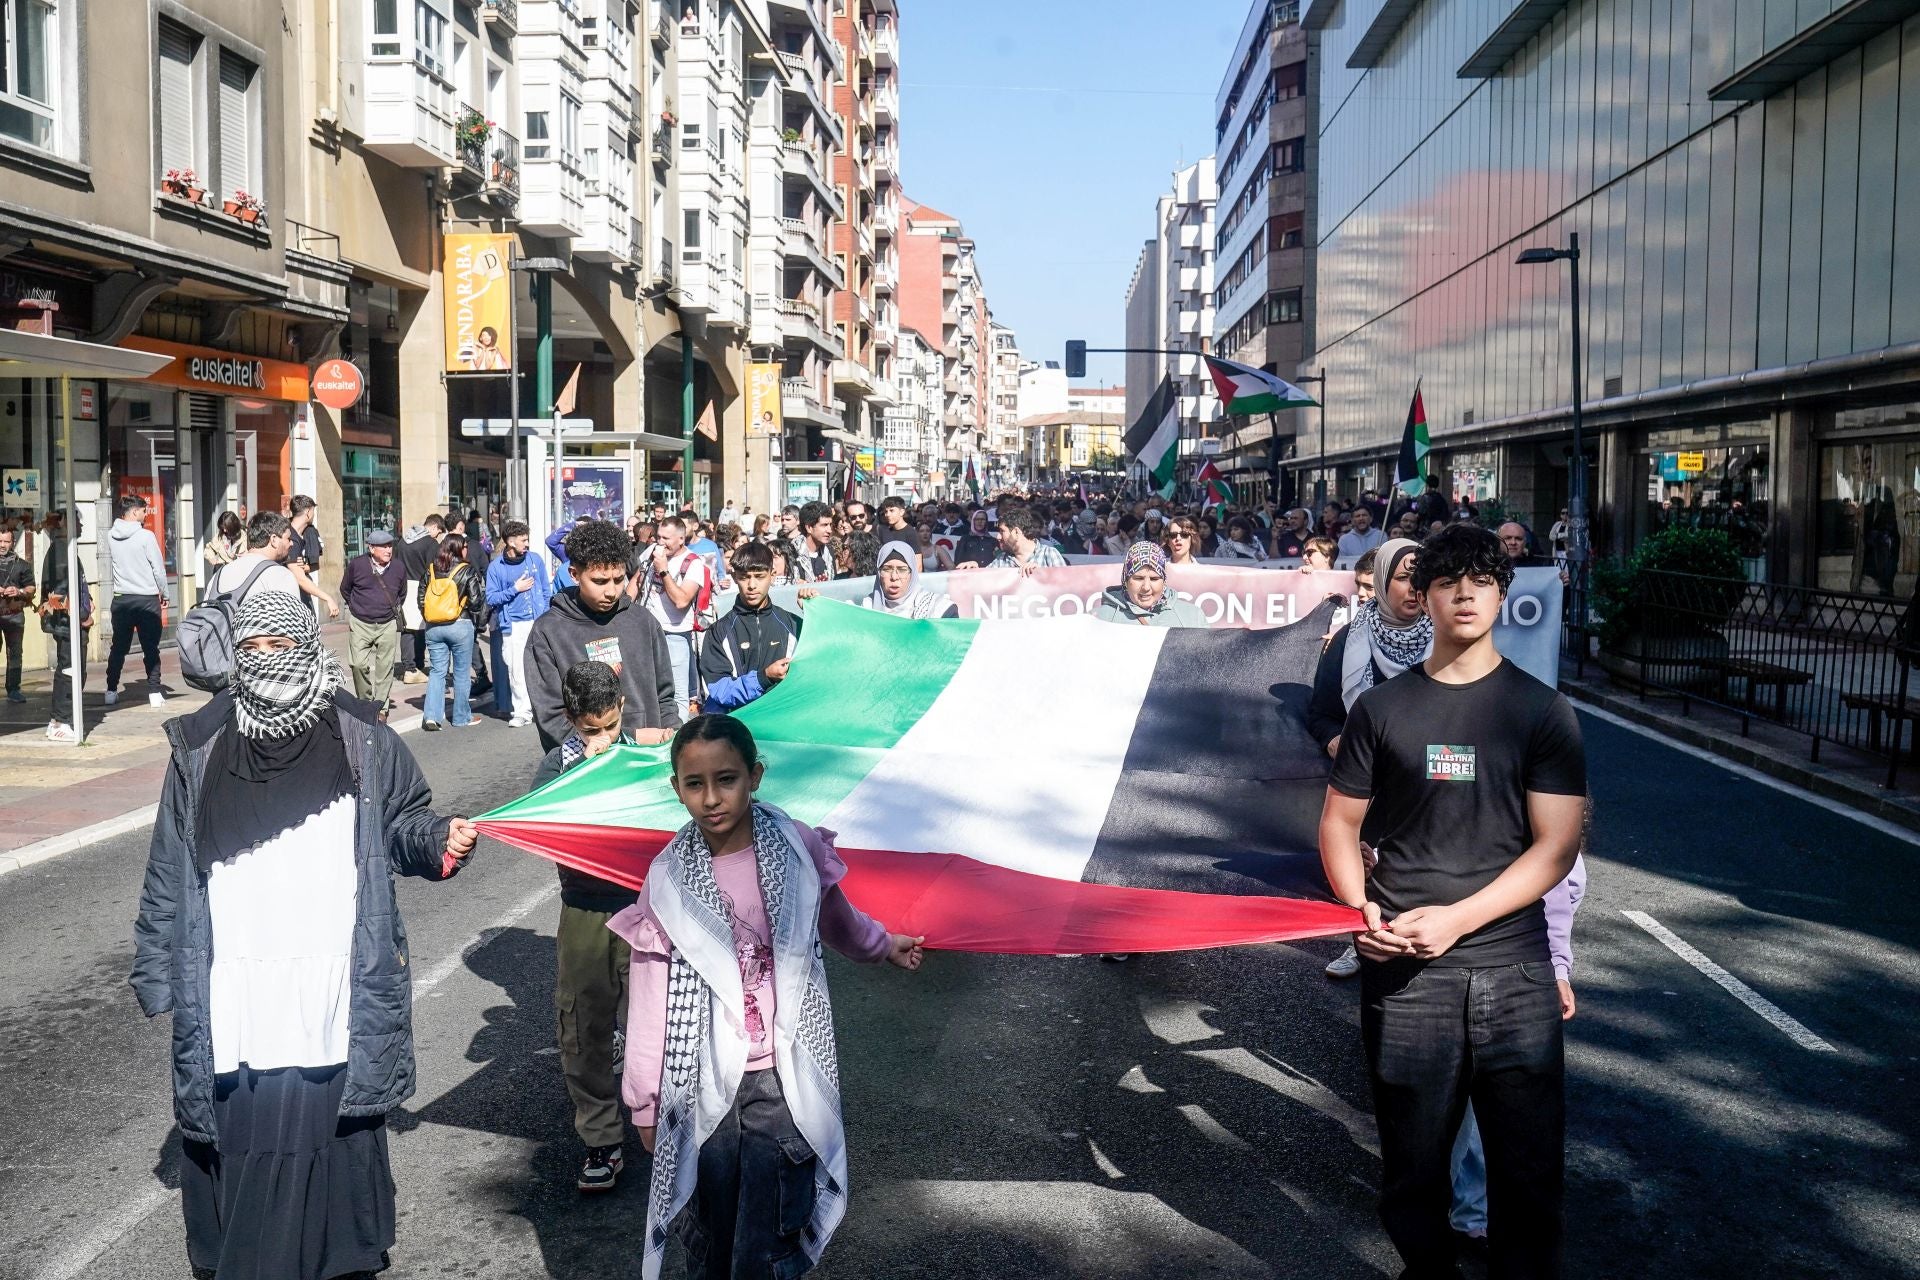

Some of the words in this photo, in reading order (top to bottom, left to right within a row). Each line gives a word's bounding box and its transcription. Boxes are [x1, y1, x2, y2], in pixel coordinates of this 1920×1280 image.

[484, 254, 497, 269] D
[456, 244, 475, 362] DENDARABA
[192, 357, 251, 388] euskaltel
[317, 381, 356, 391] euskaltel
[1266, 593, 1301, 624] EL
[1429, 753, 1473, 762] PALESTINA
[1428, 761, 1474, 775] LIBRE!
